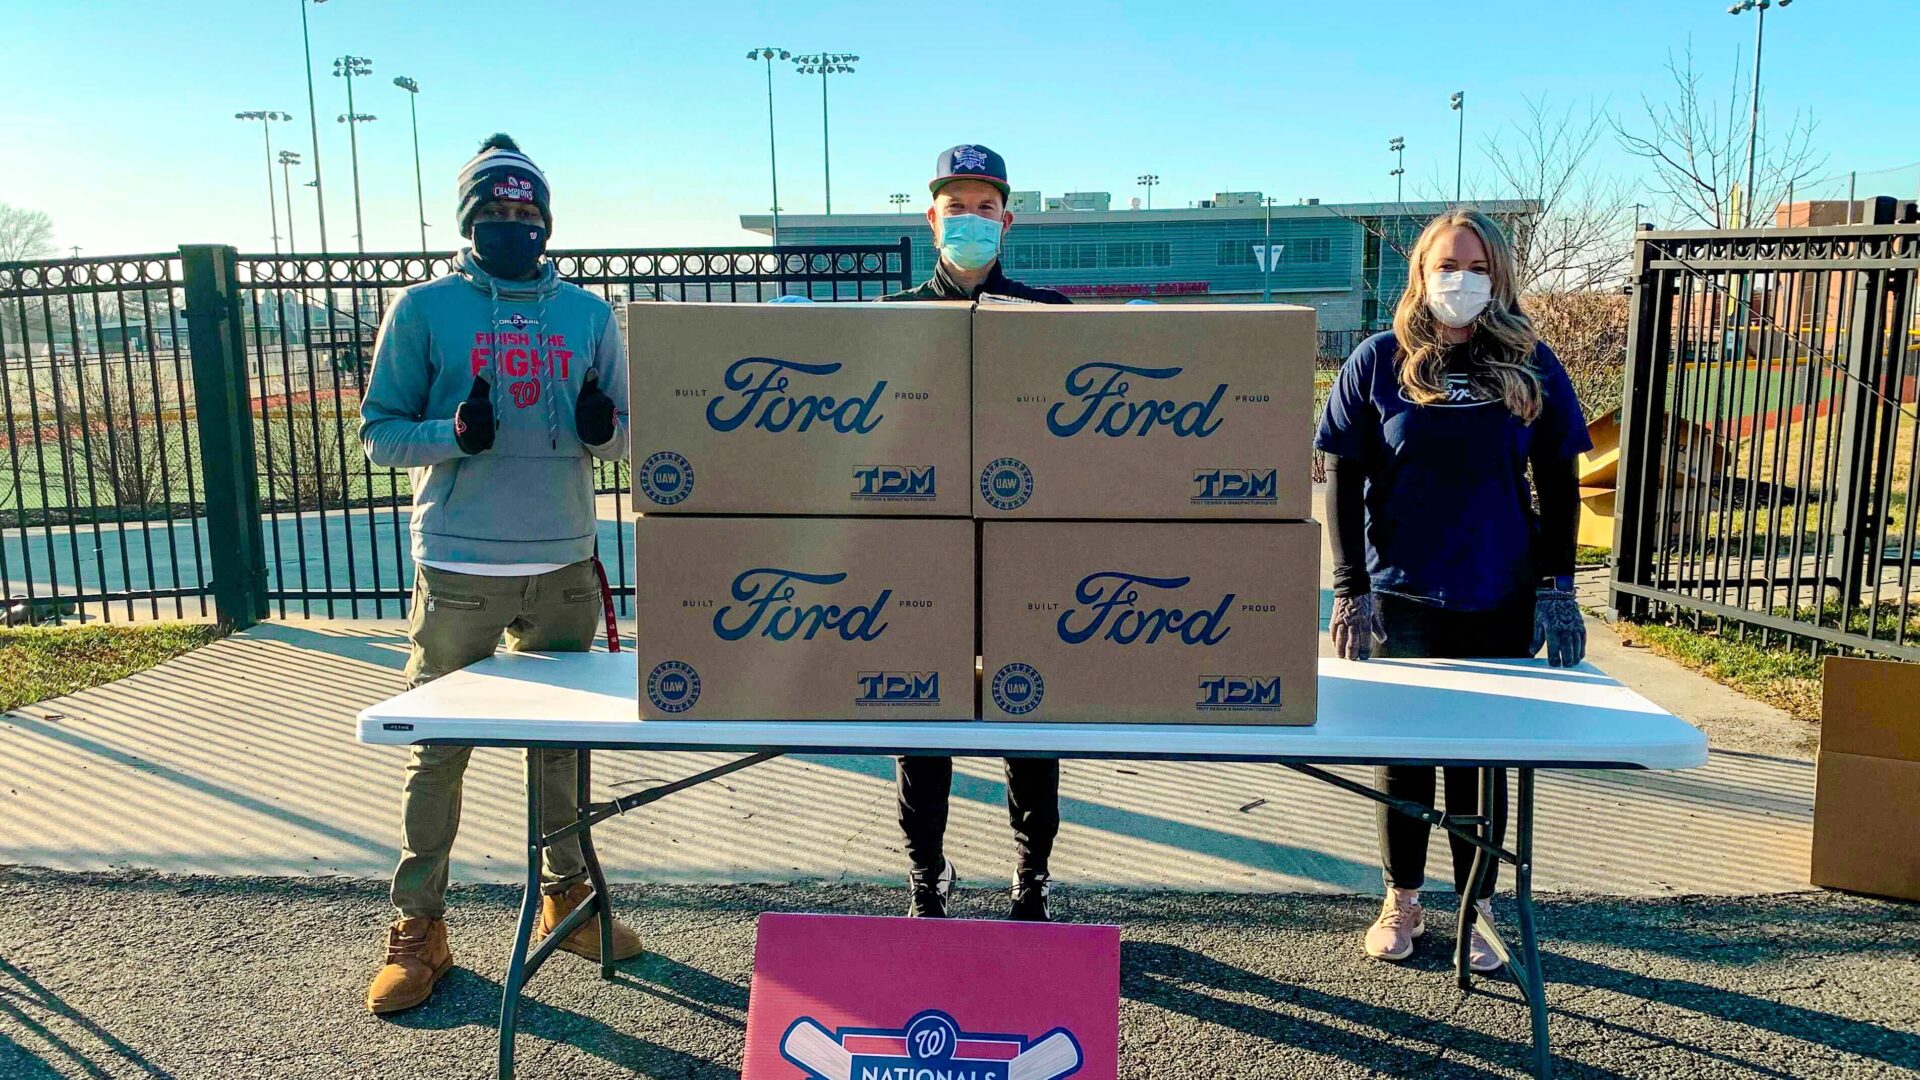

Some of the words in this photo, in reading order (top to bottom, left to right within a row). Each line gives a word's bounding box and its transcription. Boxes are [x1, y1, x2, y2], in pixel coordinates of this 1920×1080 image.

[494, 186, 533, 200] CHAMPIONS
[535, 334, 566, 347] THE
[470, 348, 574, 379] FIGHT
[675, 389, 708, 397] BUILT
[706, 357, 888, 434] Ford
[895, 392, 930, 400] PROUD
[1046, 362, 1229, 438] Ford
[656, 472, 678, 484] UAW
[852, 465, 935, 494] TDM
[996, 478, 1017, 489] UAW
[1192, 468, 1277, 497] TDM
[713, 568, 893, 641] Ford
[1027, 603, 1059, 611] BUILT
[1057, 571, 1236, 645] Ford
[663, 681, 684, 692] UAW
[857, 671, 939, 699] TDM
[1007, 683, 1028, 694] UAW
[1199, 675, 1281, 704] TDM
[915, 1026, 946, 1058] W
